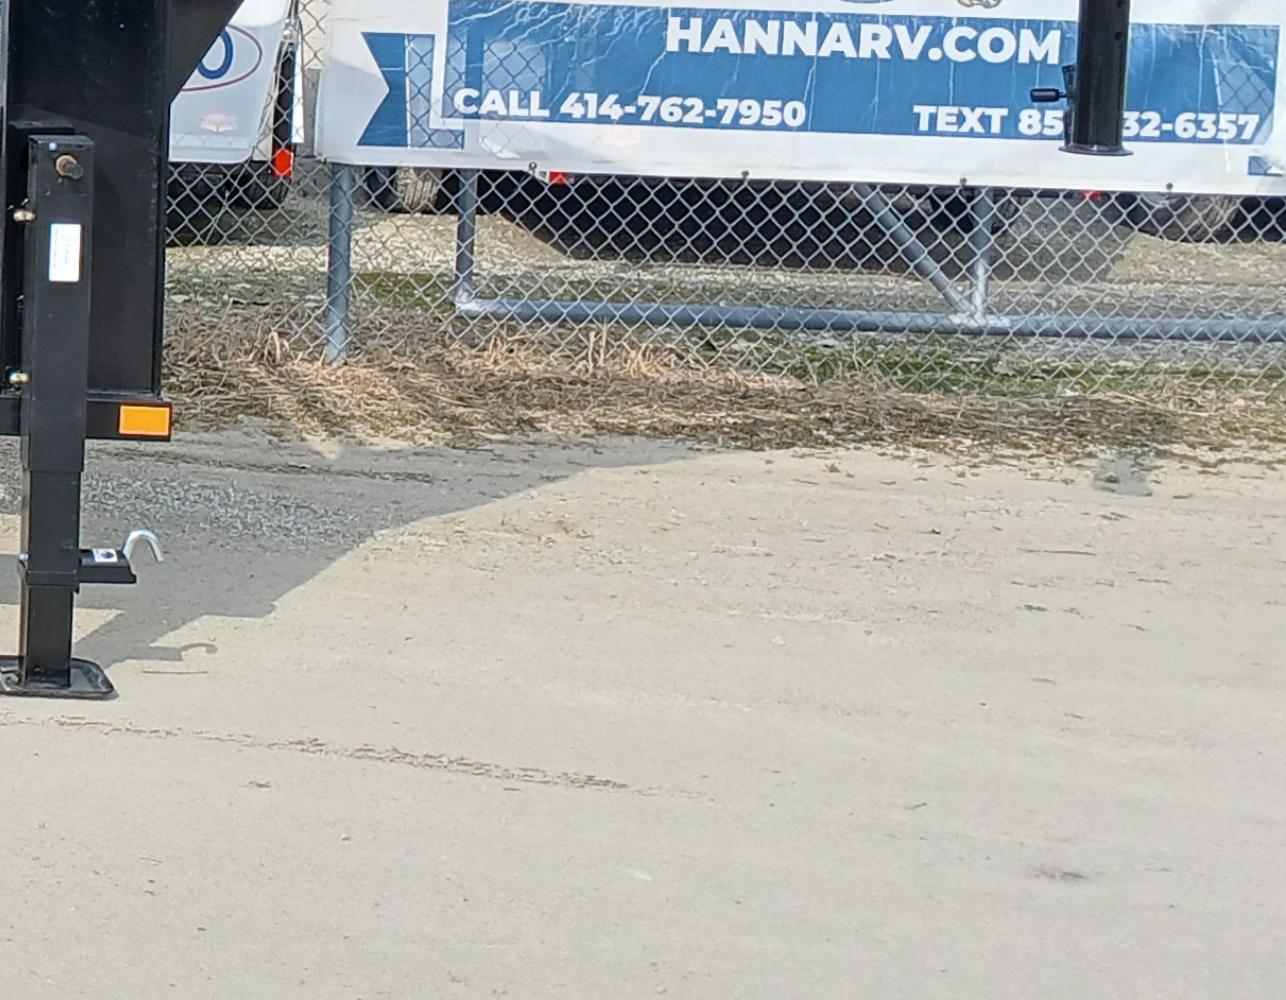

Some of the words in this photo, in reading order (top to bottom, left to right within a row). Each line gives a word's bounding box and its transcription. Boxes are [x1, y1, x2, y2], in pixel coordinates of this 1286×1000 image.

[666, 16, 1061, 65] HANNARV.COM
[454, 88, 549, 119] CALL
[561, 94, 806, 127] 414-762-7950
[913, 105, 1008, 134] TEXT
[1018, 109, 1259, 140] 8532-6357
